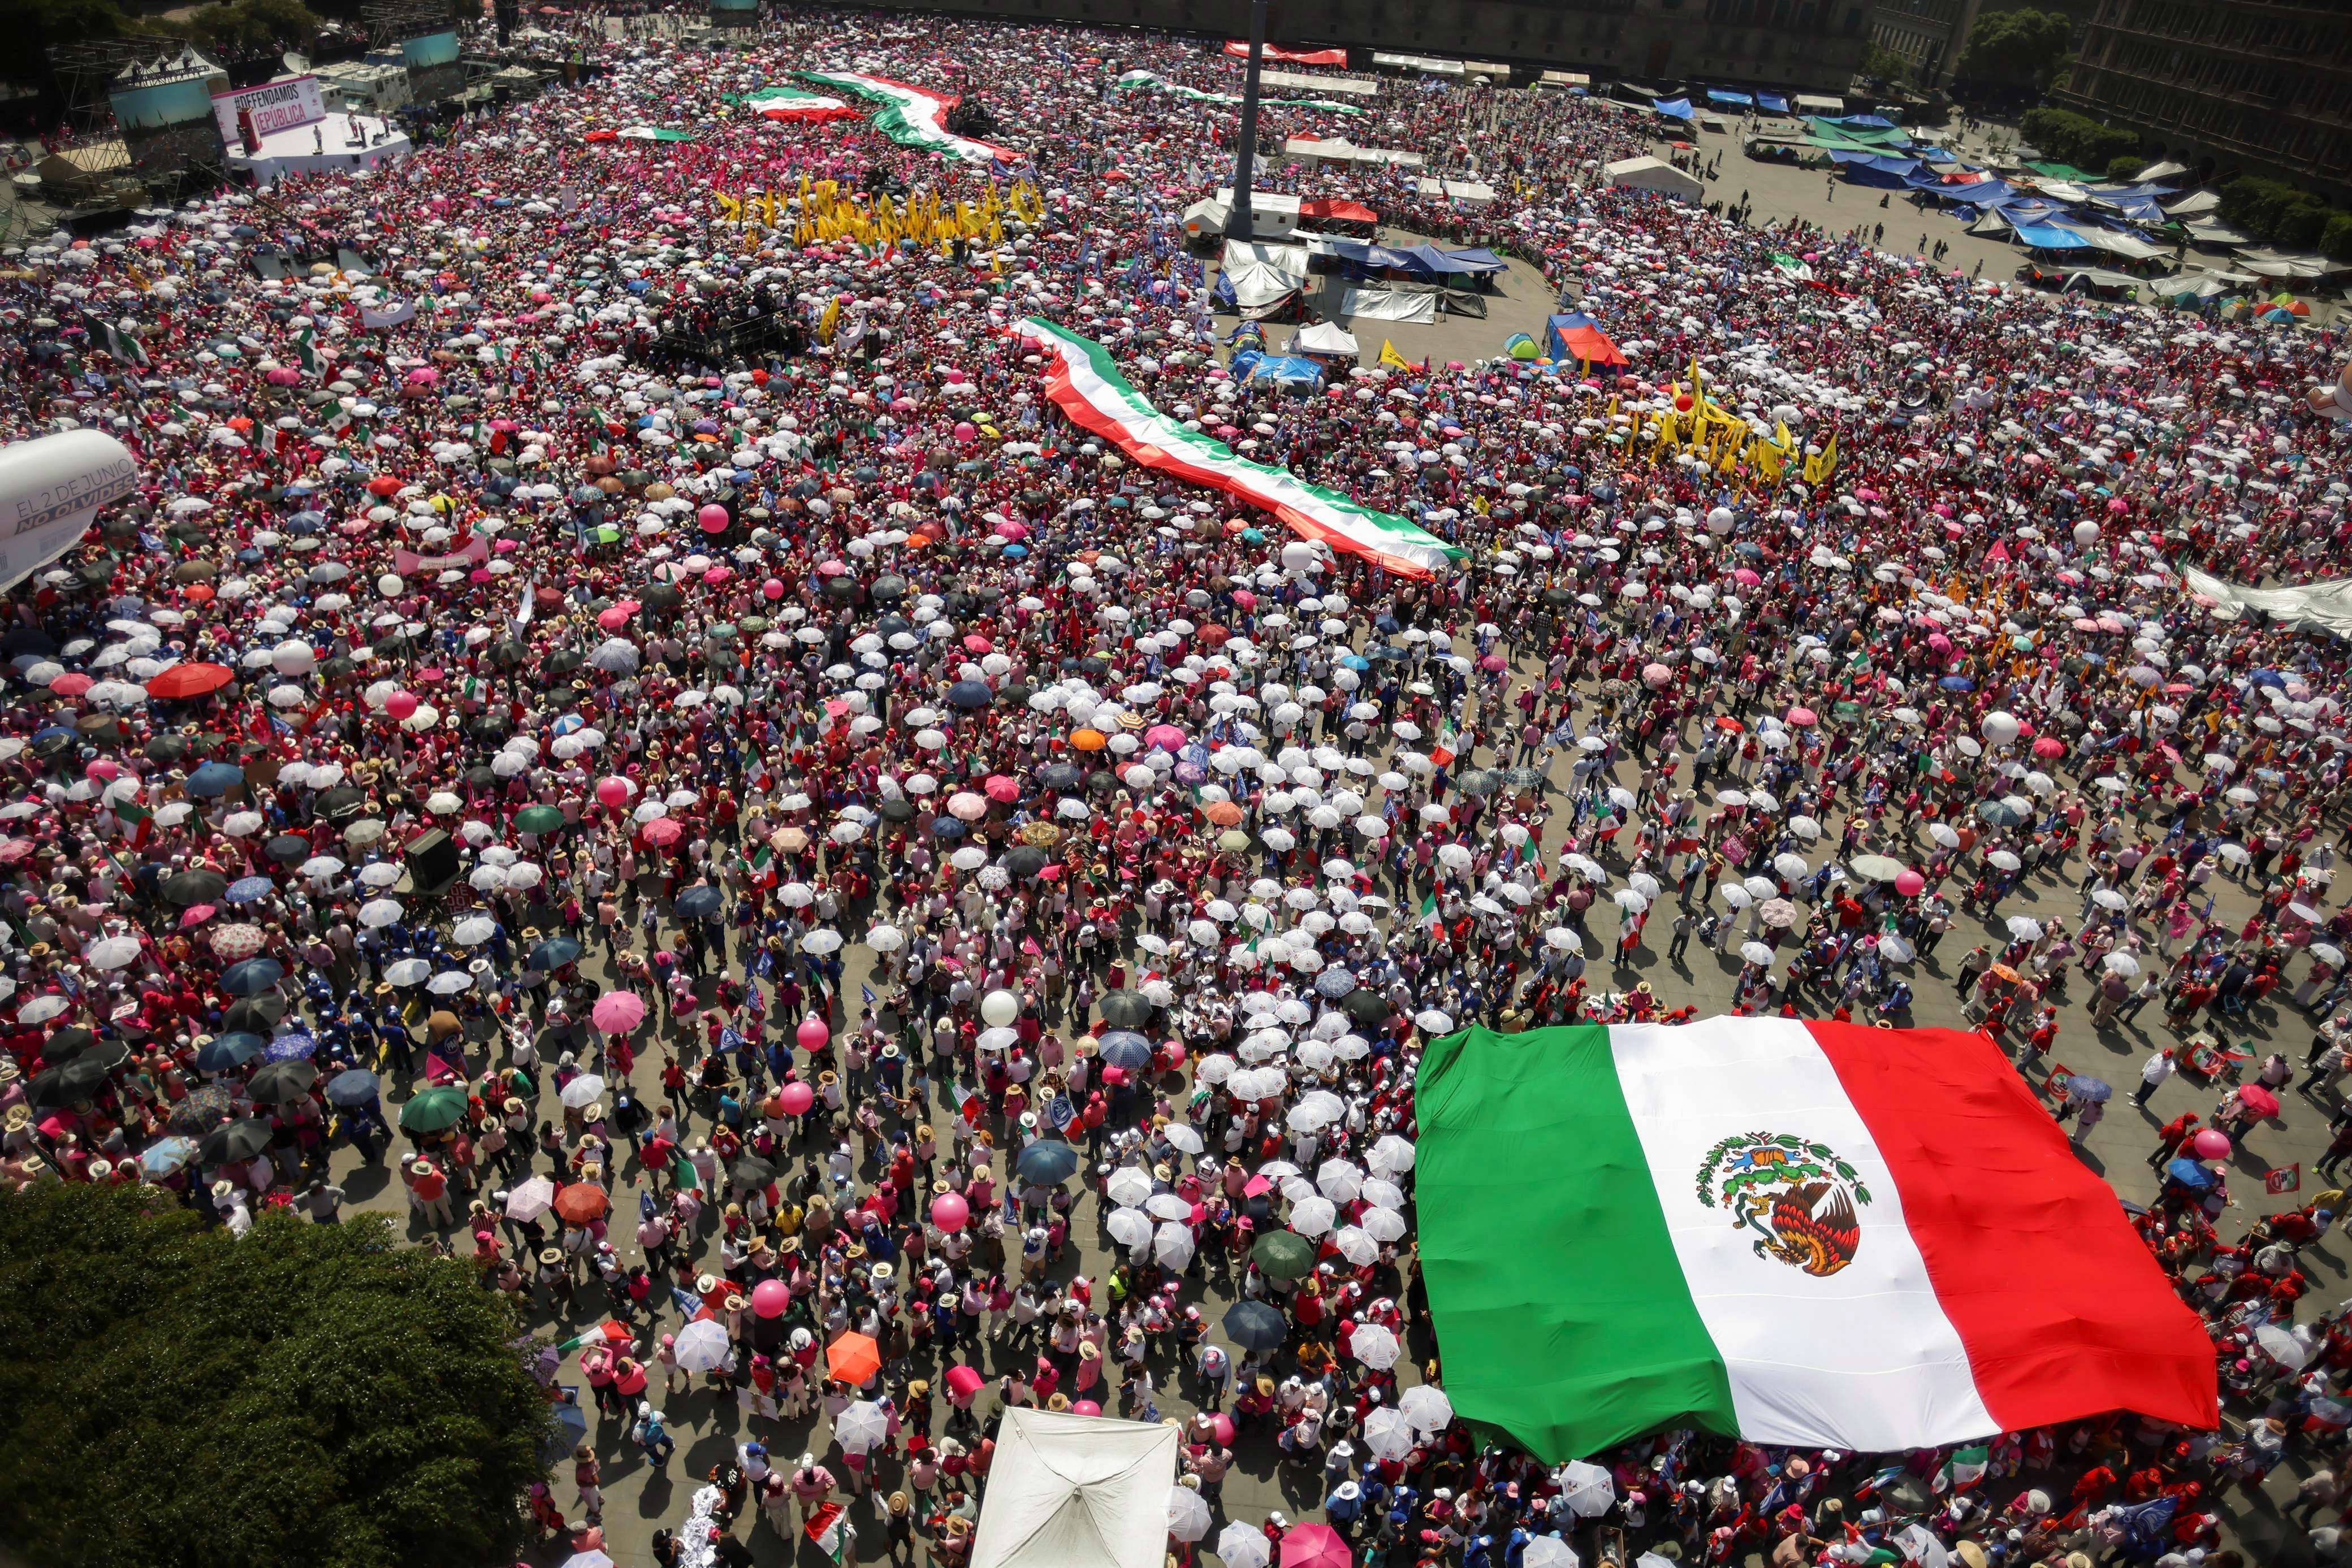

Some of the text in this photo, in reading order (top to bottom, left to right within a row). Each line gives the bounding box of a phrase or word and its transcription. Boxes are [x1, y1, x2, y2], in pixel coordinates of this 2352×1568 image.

[234, 84, 299, 111] #DEFENDAMOS
[16, 458, 131, 518] EL 2 DE JUNIO
[18, 475, 135, 534] NO OLVIDES
[1234, 727, 1245, 742] PAN
[1054, 1102, 1068, 1120] PAN
